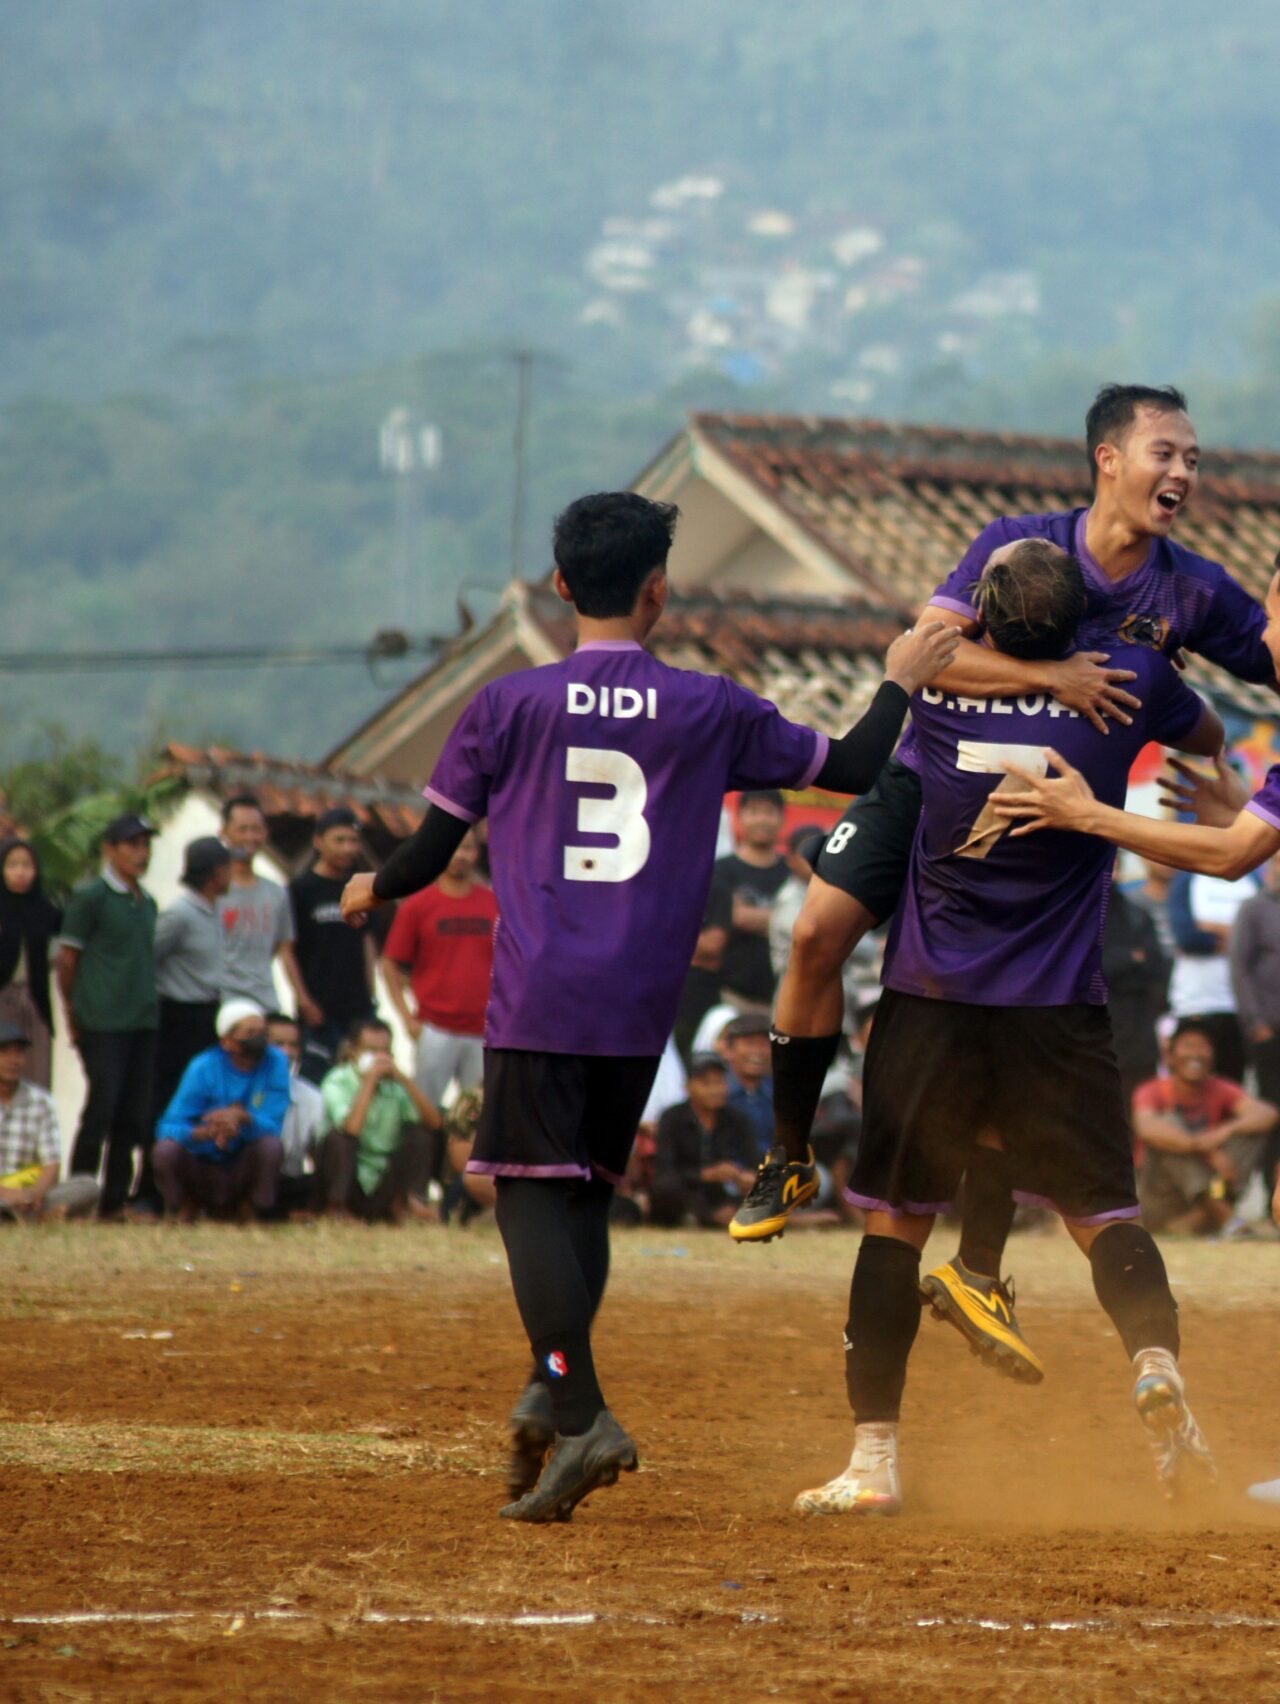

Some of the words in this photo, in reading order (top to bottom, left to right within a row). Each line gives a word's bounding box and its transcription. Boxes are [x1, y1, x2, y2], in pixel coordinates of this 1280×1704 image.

[566, 682, 657, 720] DIDI
[563, 746, 651, 883] 3
[825, 821, 858, 855] 8
[953, 739, 1051, 859] 7
